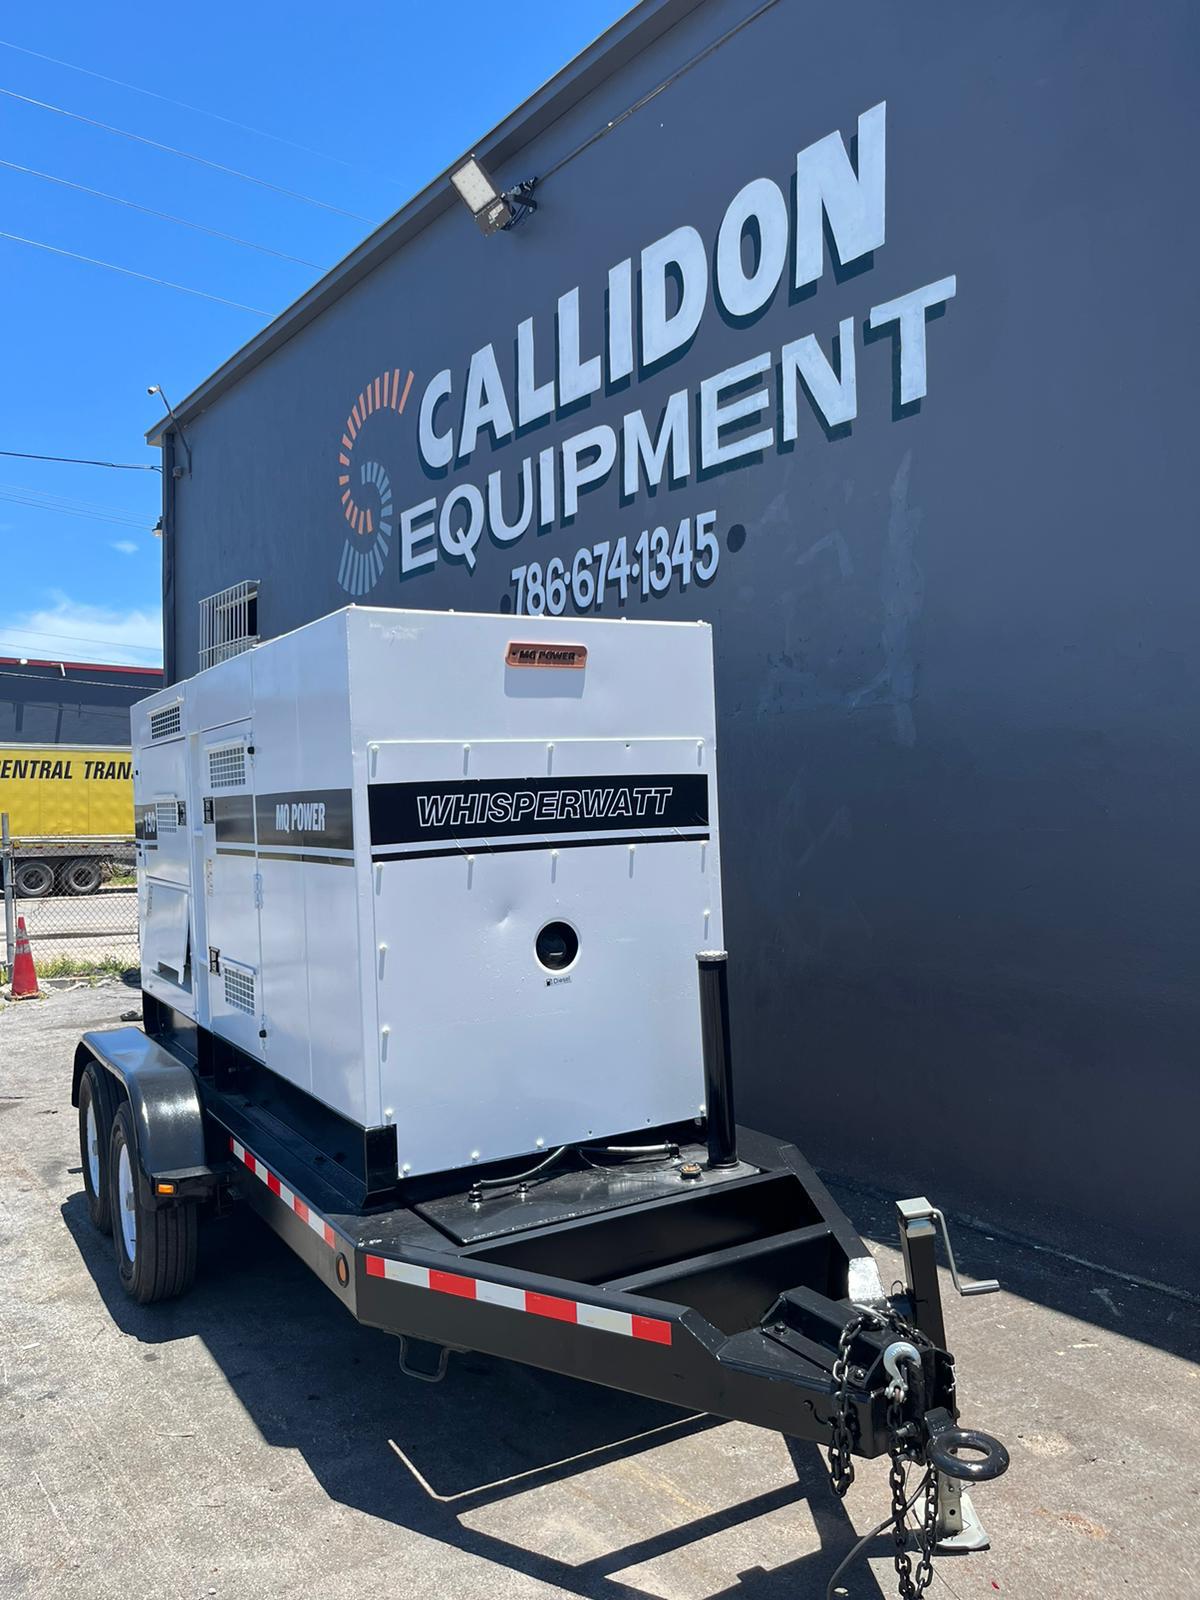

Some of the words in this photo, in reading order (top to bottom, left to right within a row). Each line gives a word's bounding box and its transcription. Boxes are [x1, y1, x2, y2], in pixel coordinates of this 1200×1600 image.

[418, 100, 887, 470] CALLIDON
[400, 274, 956, 574] EQUIPMENT
[538, 650, 575, 662] POWER
[0, 759, 72, 779] ENTRAL
[84, 760, 133, 780] TRAN
[275, 803, 290, 833] MQ
[291, 802, 326, 831] POWER
[416, 787, 673, 827] WHISPERWATT
